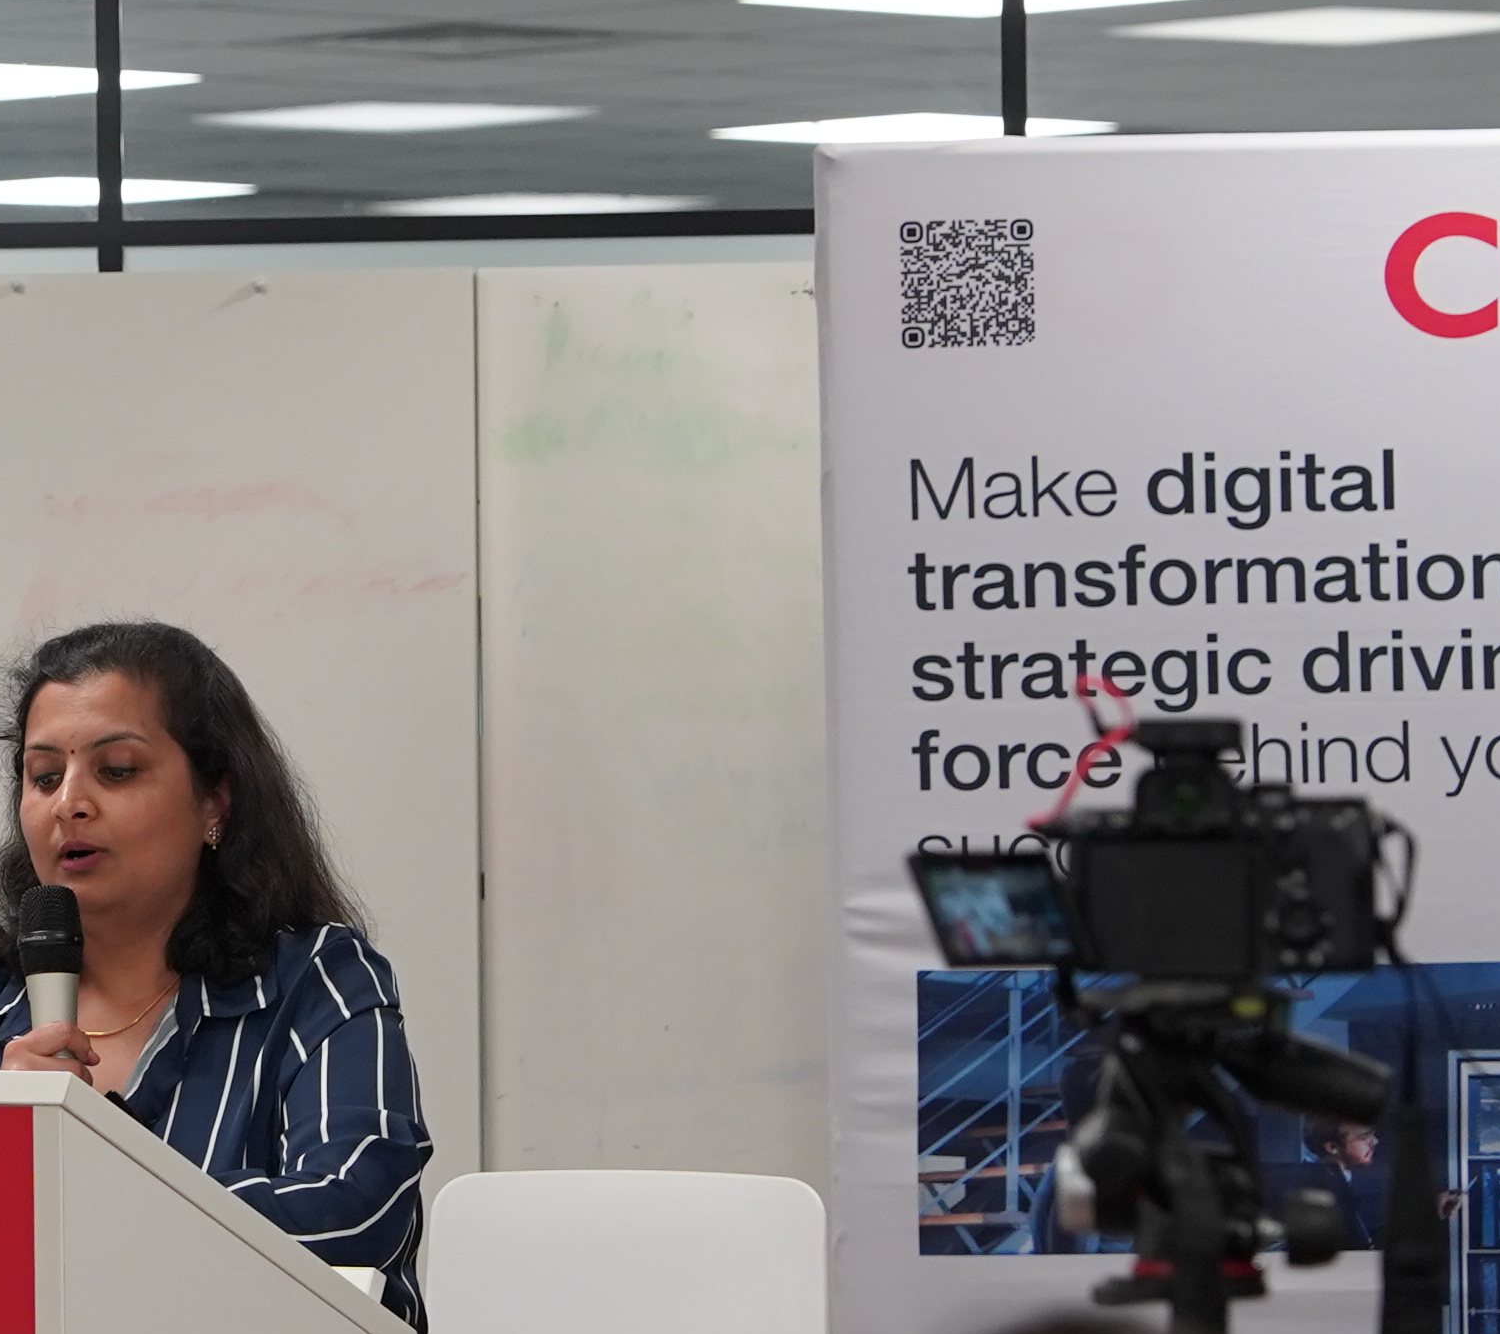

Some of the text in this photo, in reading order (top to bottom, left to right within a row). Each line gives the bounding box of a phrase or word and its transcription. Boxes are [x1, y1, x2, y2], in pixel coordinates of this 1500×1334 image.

[909, 448, 1396, 531] Make digital
[911, 633, 1272, 713] strategic
[911, 729, 1123, 792] force
[1214, 720, 1411, 785] hind
